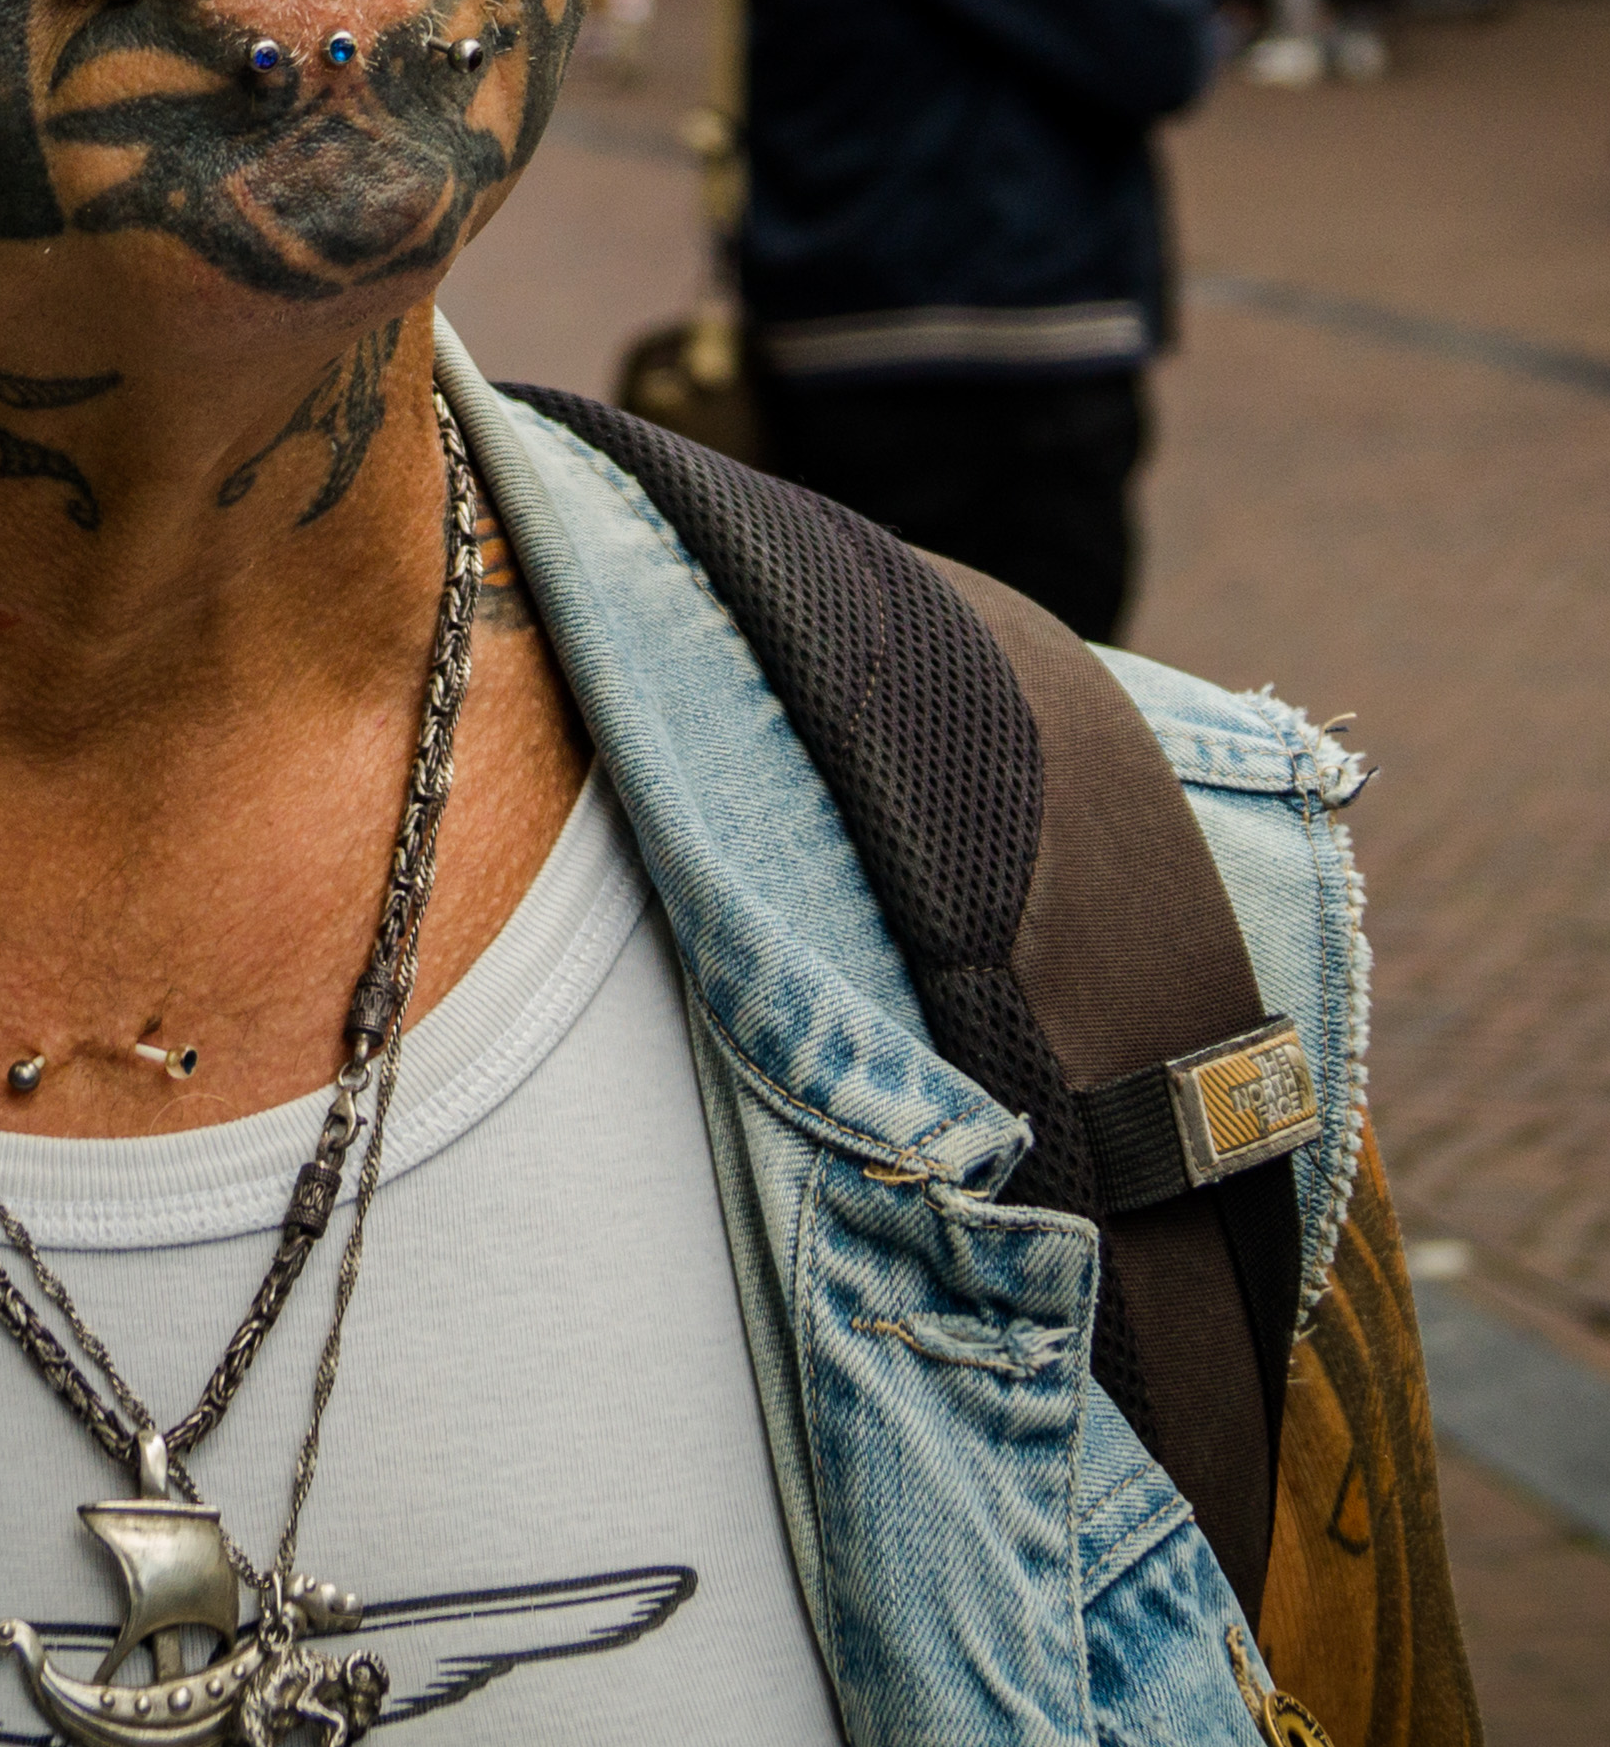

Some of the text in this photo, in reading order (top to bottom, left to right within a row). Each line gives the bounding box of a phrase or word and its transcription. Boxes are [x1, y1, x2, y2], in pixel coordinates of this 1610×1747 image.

[1252, 1048, 1291, 1079] THE
[1231, 1067, 1298, 1114] NORTH
[1258, 1091, 1302, 1132] FACE
